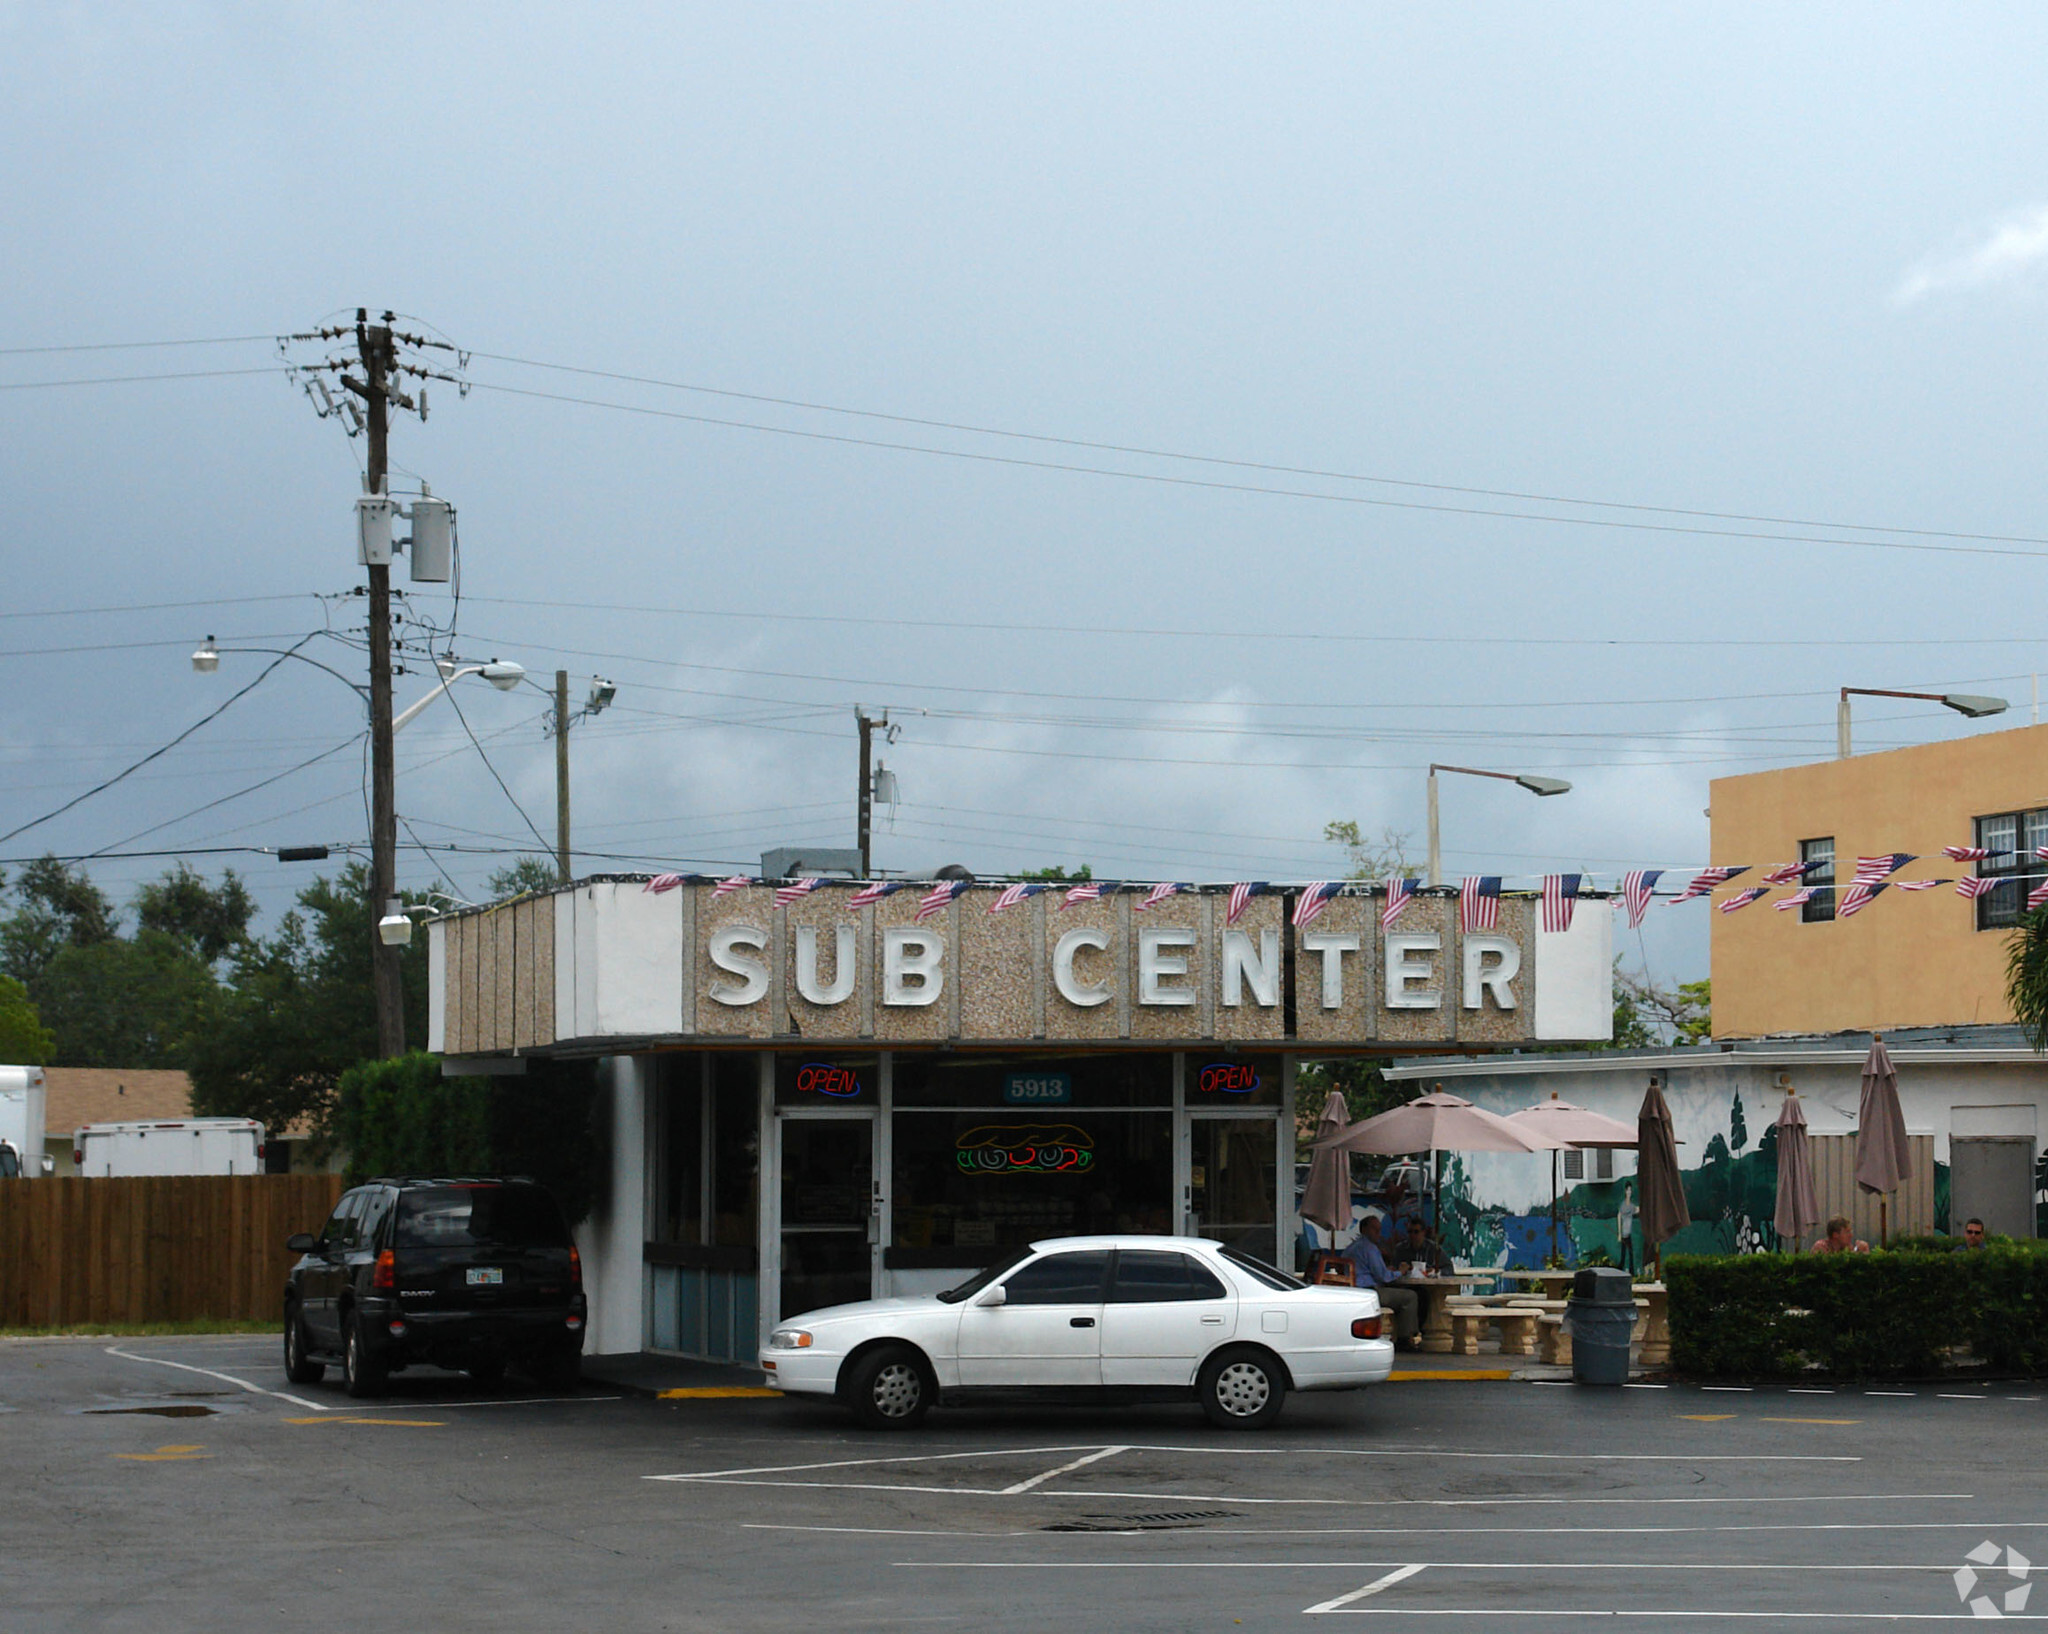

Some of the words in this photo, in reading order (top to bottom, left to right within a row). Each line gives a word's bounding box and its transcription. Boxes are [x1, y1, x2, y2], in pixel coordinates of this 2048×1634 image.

[708, 924, 946, 1006] SUB
[1053, 928, 1521, 1010] CENTER
[797, 1067, 857, 1093] OPEN
[1011, 1079, 1063, 1097] 5913
[1199, 1064, 1255, 1092] OPEN
